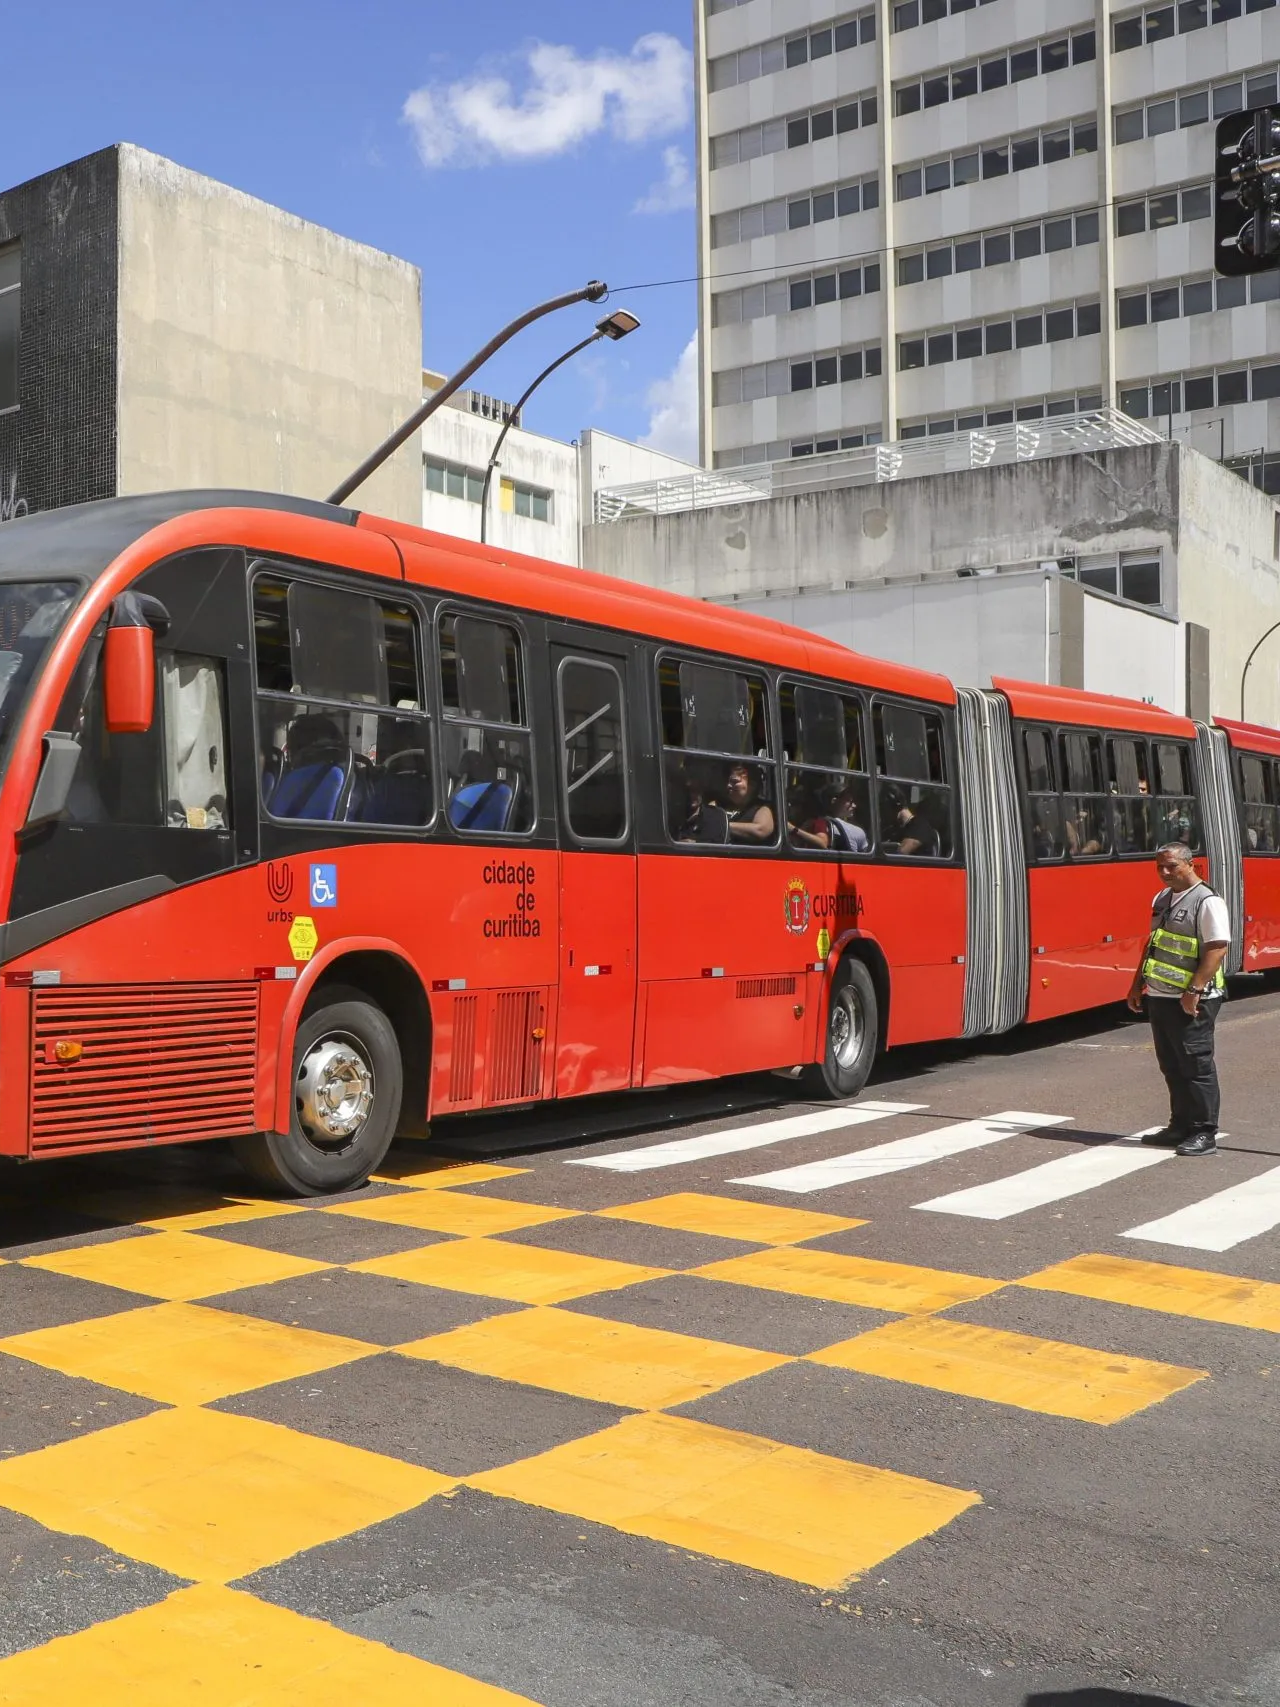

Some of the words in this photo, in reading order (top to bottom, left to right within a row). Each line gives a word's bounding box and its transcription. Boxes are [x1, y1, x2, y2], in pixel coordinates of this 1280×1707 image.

[483, 859, 535, 885] cidade
[516, 891, 535, 911] de
[812, 894, 864, 918] CURITIBA
[267, 908, 294, 923] urbs
[483, 913, 541, 938] curitiba
